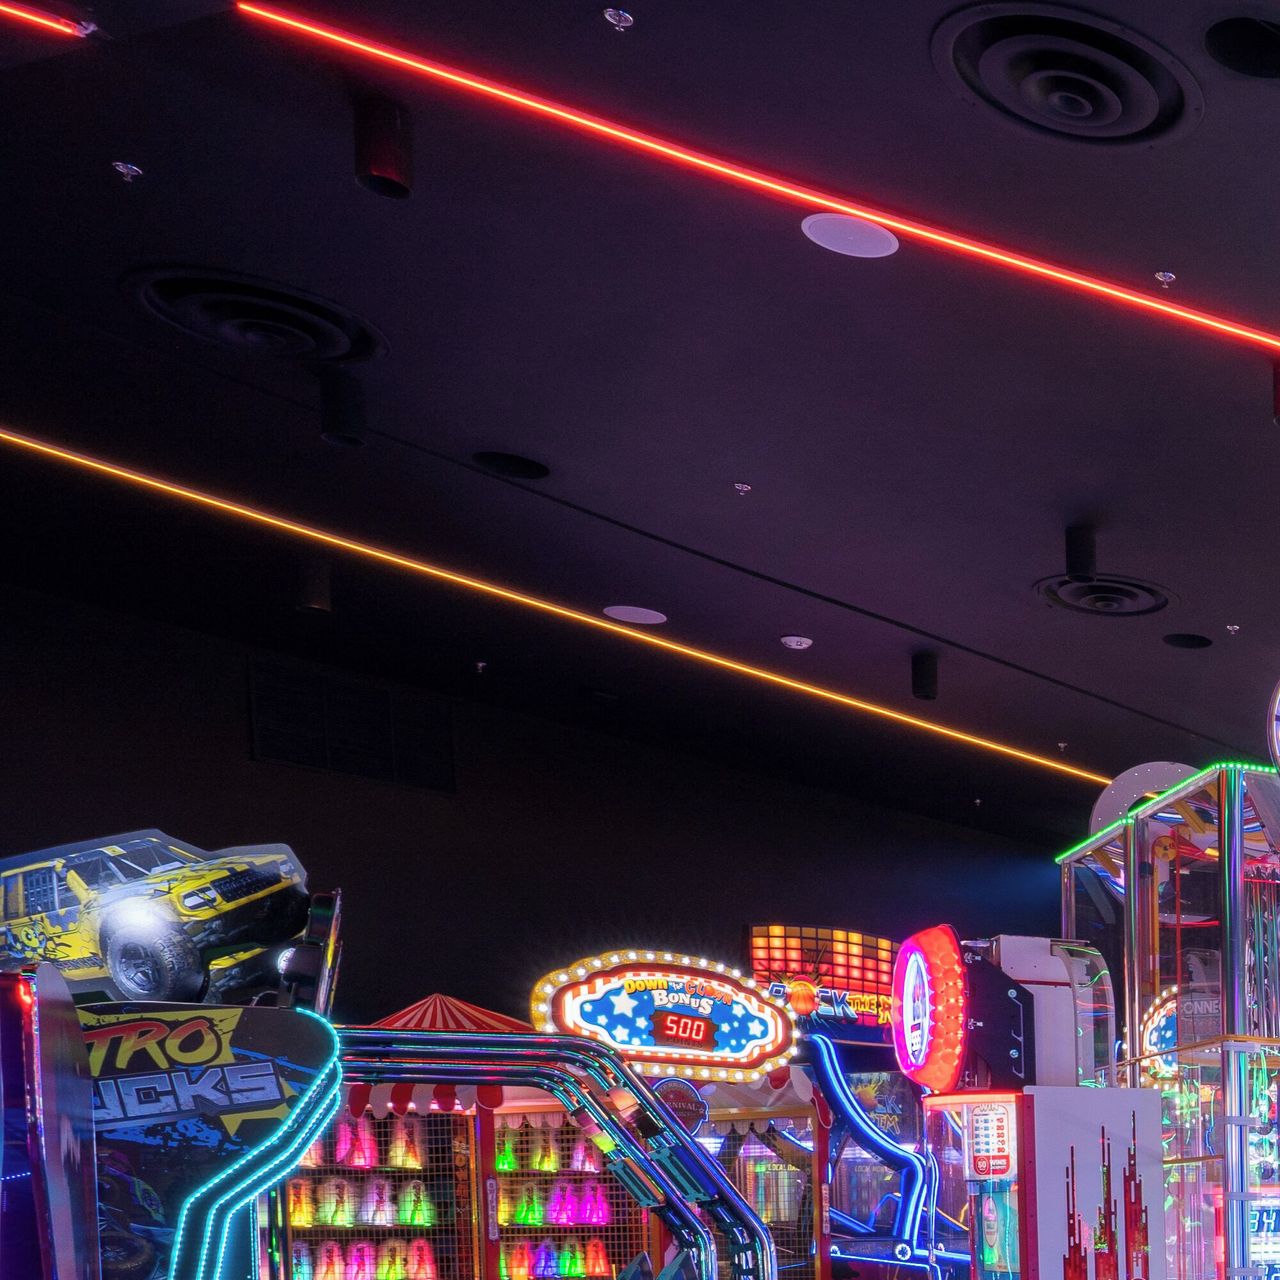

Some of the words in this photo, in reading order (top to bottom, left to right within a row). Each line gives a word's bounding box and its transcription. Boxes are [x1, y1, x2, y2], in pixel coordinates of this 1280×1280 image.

[624, 979, 669, 994] Down
[664, 1015, 705, 1040] 500
[84, 1018, 218, 1077] TRO
